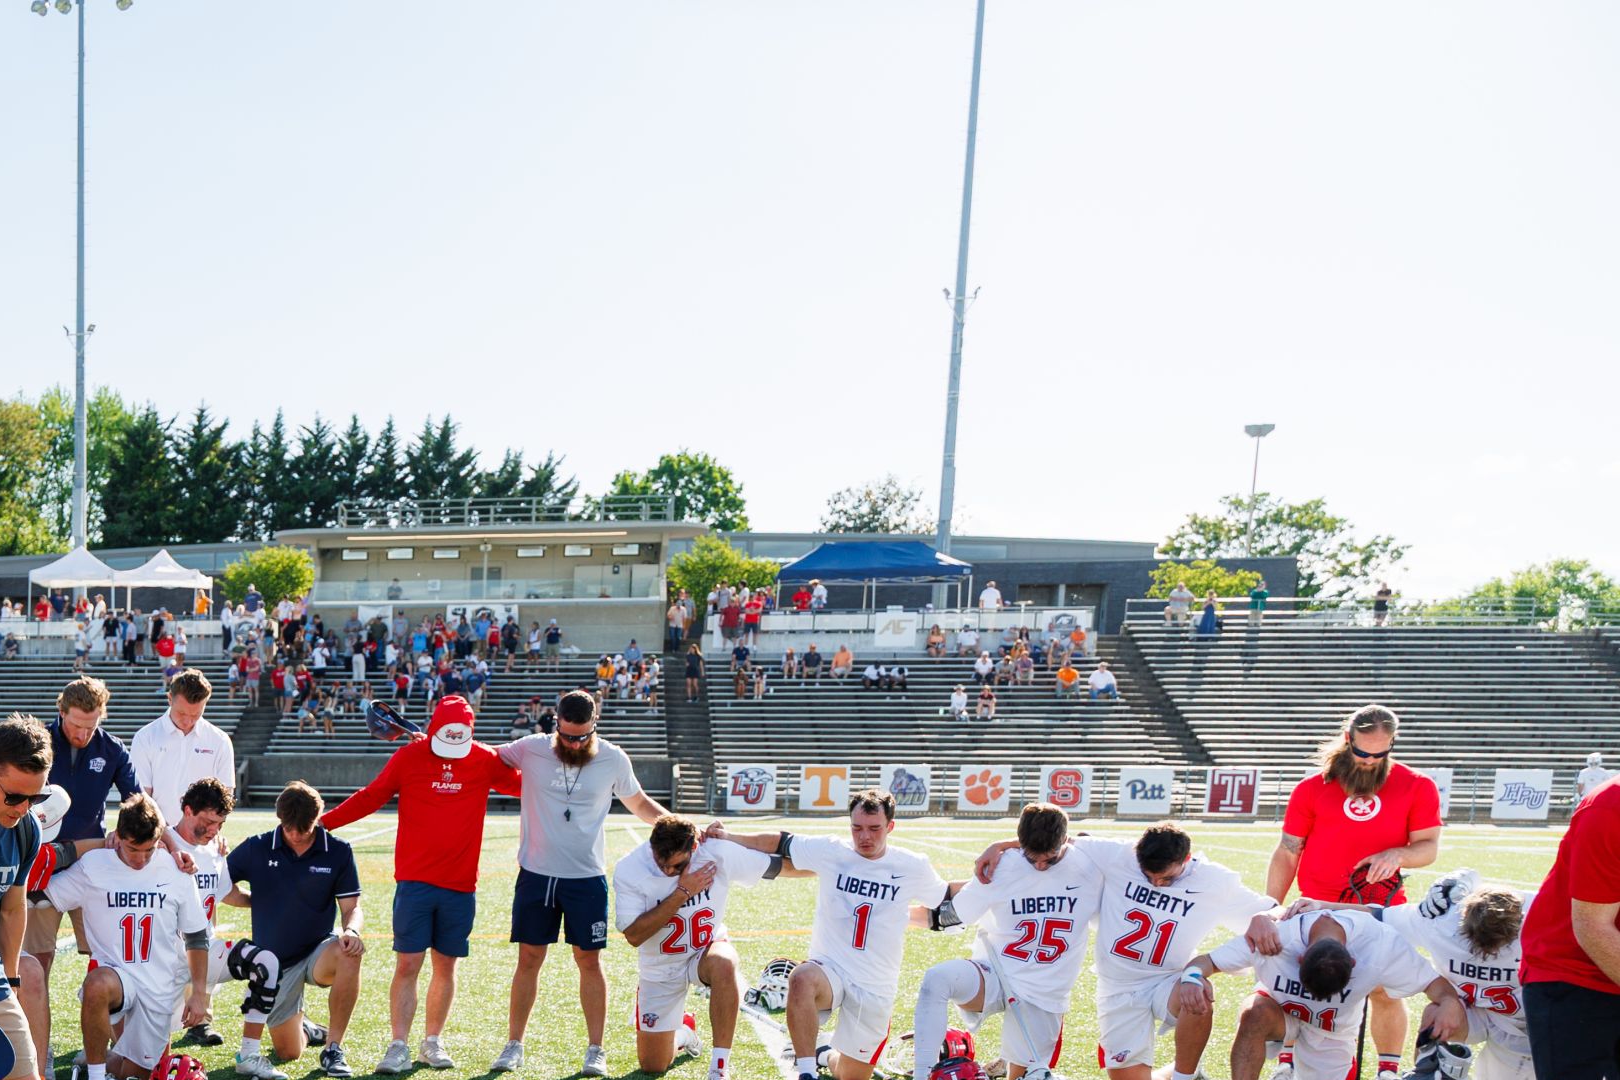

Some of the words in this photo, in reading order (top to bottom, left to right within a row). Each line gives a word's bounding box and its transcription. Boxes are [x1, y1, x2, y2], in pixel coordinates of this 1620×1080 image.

[432, 782, 463, 790] FLAMES
[805, 767, 847, 806] T
[1125, 779, 1166, 800] Pitt
[1214, 769, 1254, 812] T
[1497, 782, 1548, 809] HPU
[107, 891, 167, 909] LIBERTY
[836, 873, 900, 901] LIBERTY
[1125, 881, 1195, 917] LIBERTY
[1011, 896, 1078, 915] LIBERTY
[120, 912, 154, 963] 11
[660, 907, 716, 955] 26
[852, 902, 873, 951] 1
[1001, 917, 1074, 964] 25
[1110, 908, 1178, 967] 21
[1449, 958, 1517, 982] LIBERT
